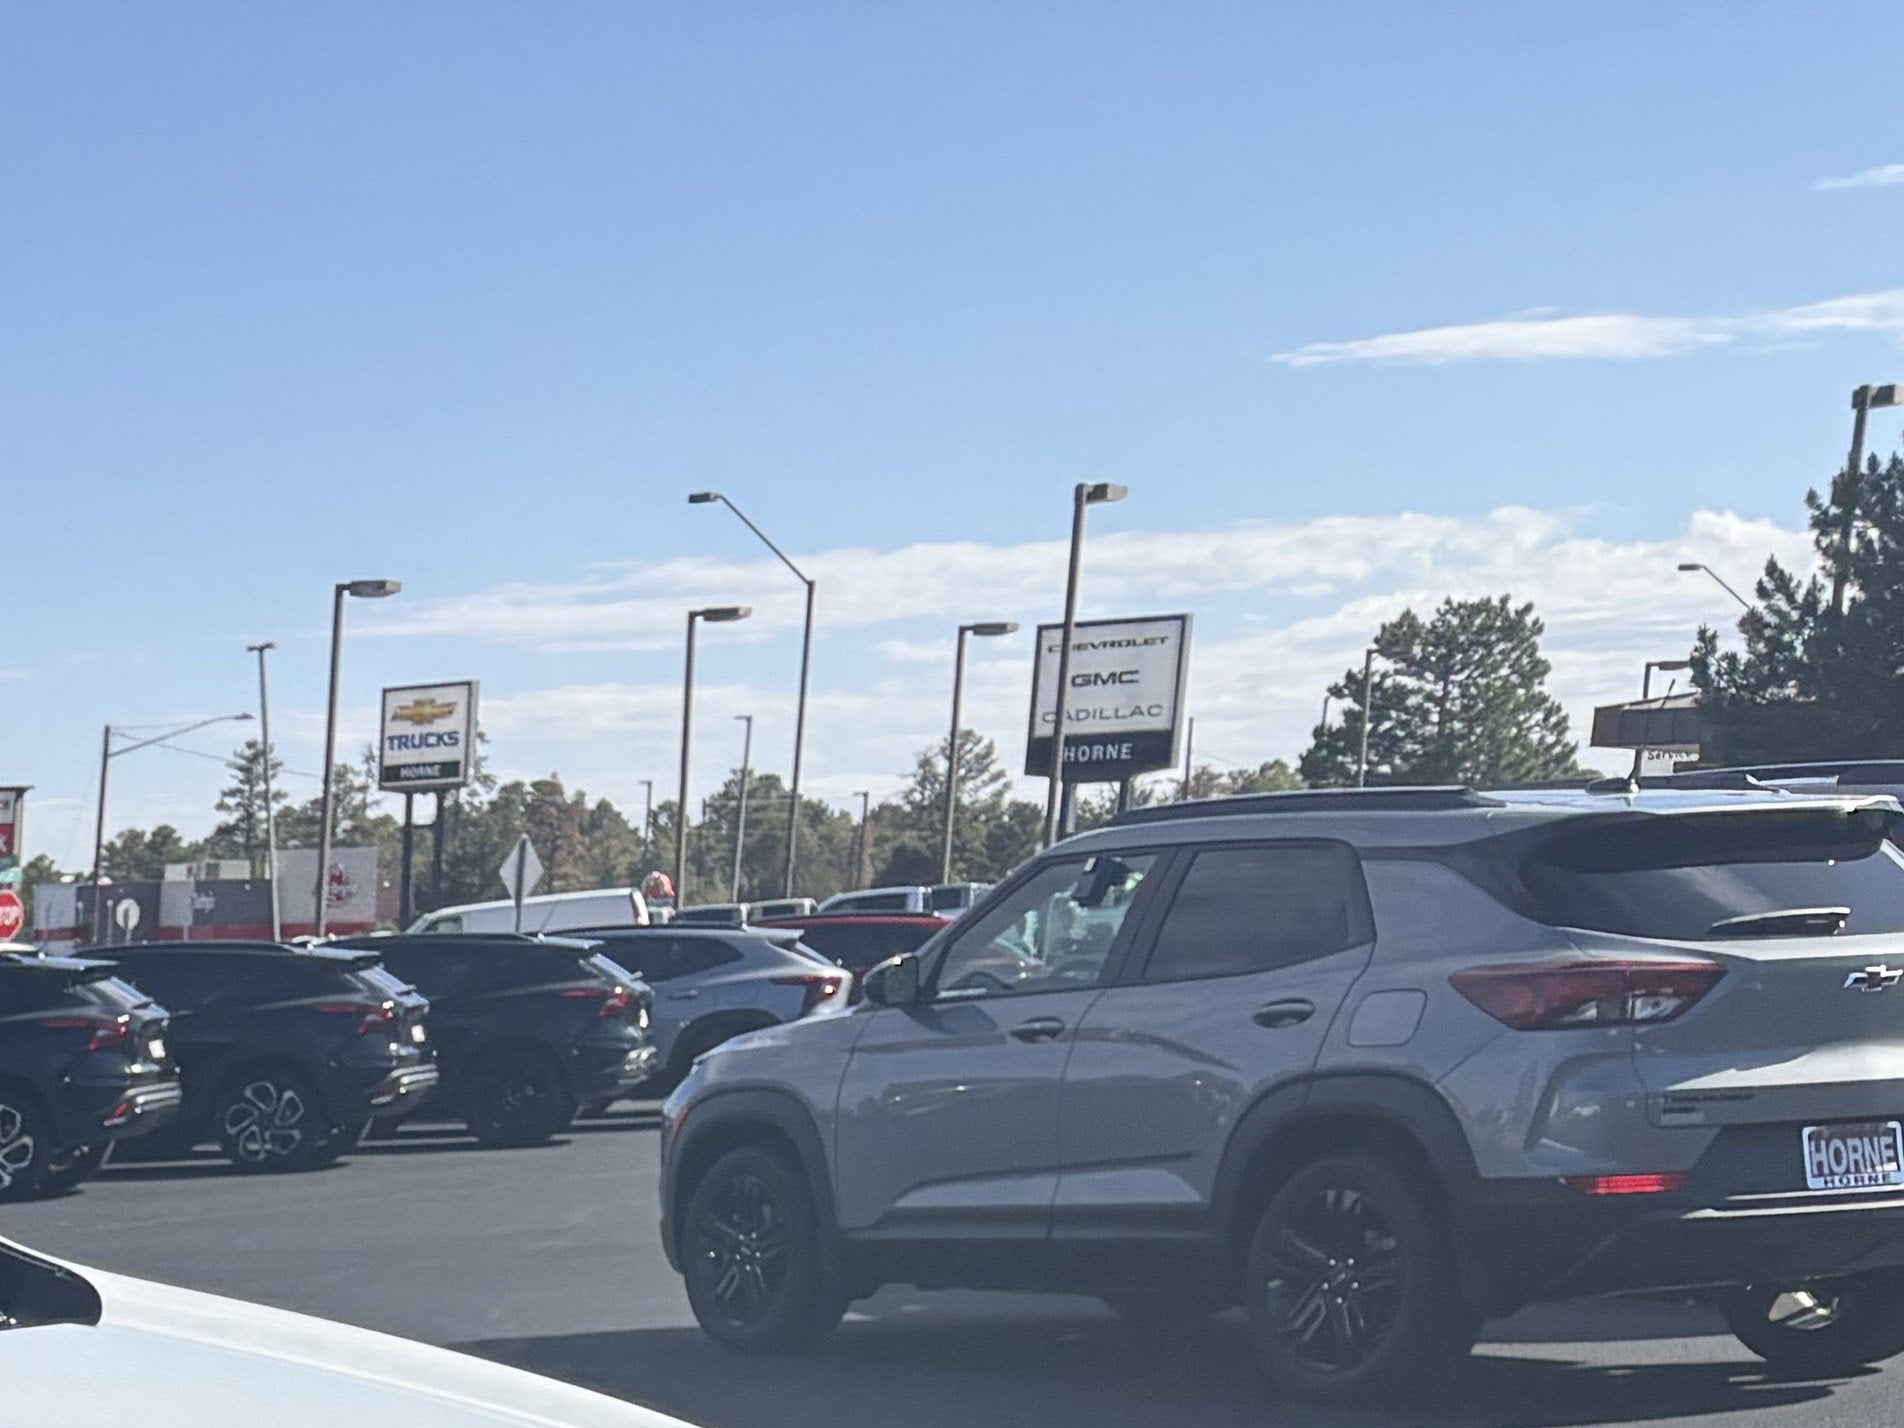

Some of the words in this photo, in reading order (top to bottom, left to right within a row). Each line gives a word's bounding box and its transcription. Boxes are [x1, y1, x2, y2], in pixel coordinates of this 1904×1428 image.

[1071, 670, 1139, 687] GMC
[387, 731, 460, 751] TRUCKS
[1064, 743, 1133, 762] HORNE
[1810, 1135, 1897, 1175] HORNE
